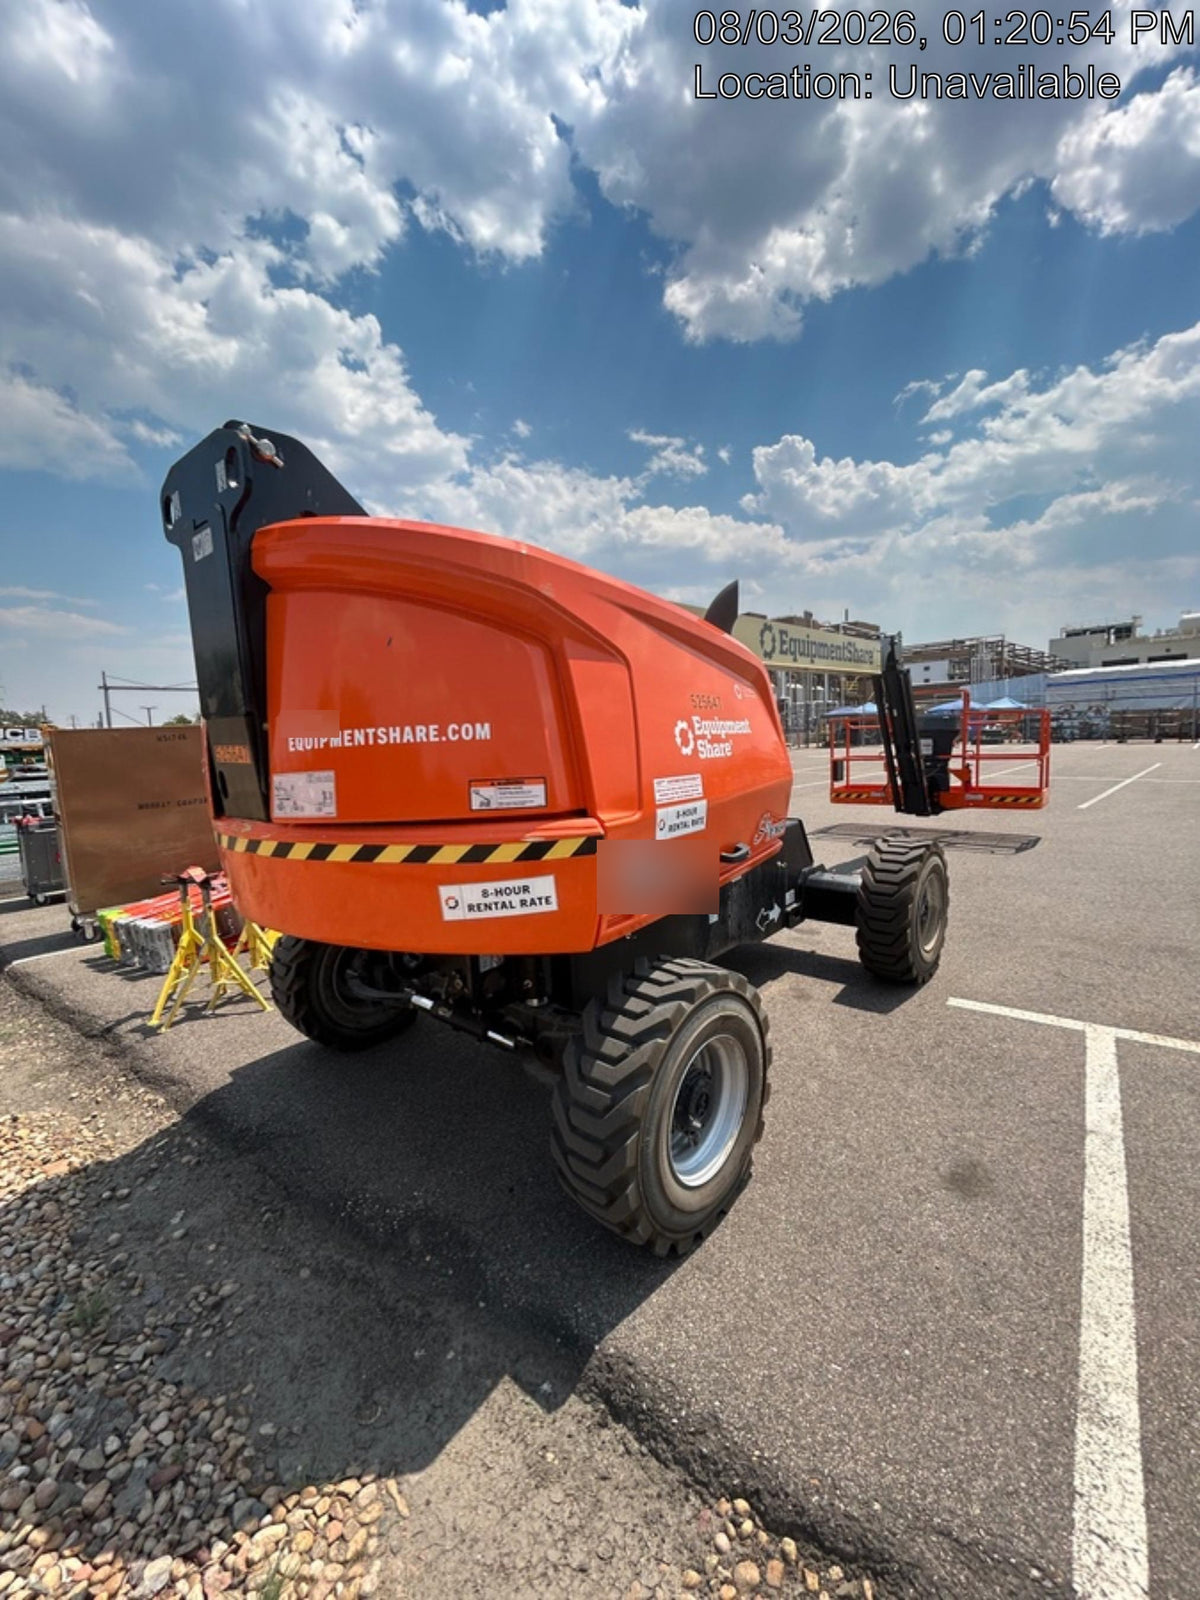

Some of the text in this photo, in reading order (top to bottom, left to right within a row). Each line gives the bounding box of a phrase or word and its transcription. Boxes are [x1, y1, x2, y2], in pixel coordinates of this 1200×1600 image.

[778, 629, 874, 665] EquipmentShare
[0, 728, 42, 741] CB
[691, 715, 752, 740] Equipment
[697, 739, 733, 760] Share
[481, 884, 531, 899] 8-HOUR
[467, 895, 553, 913] RENTAL RATE
